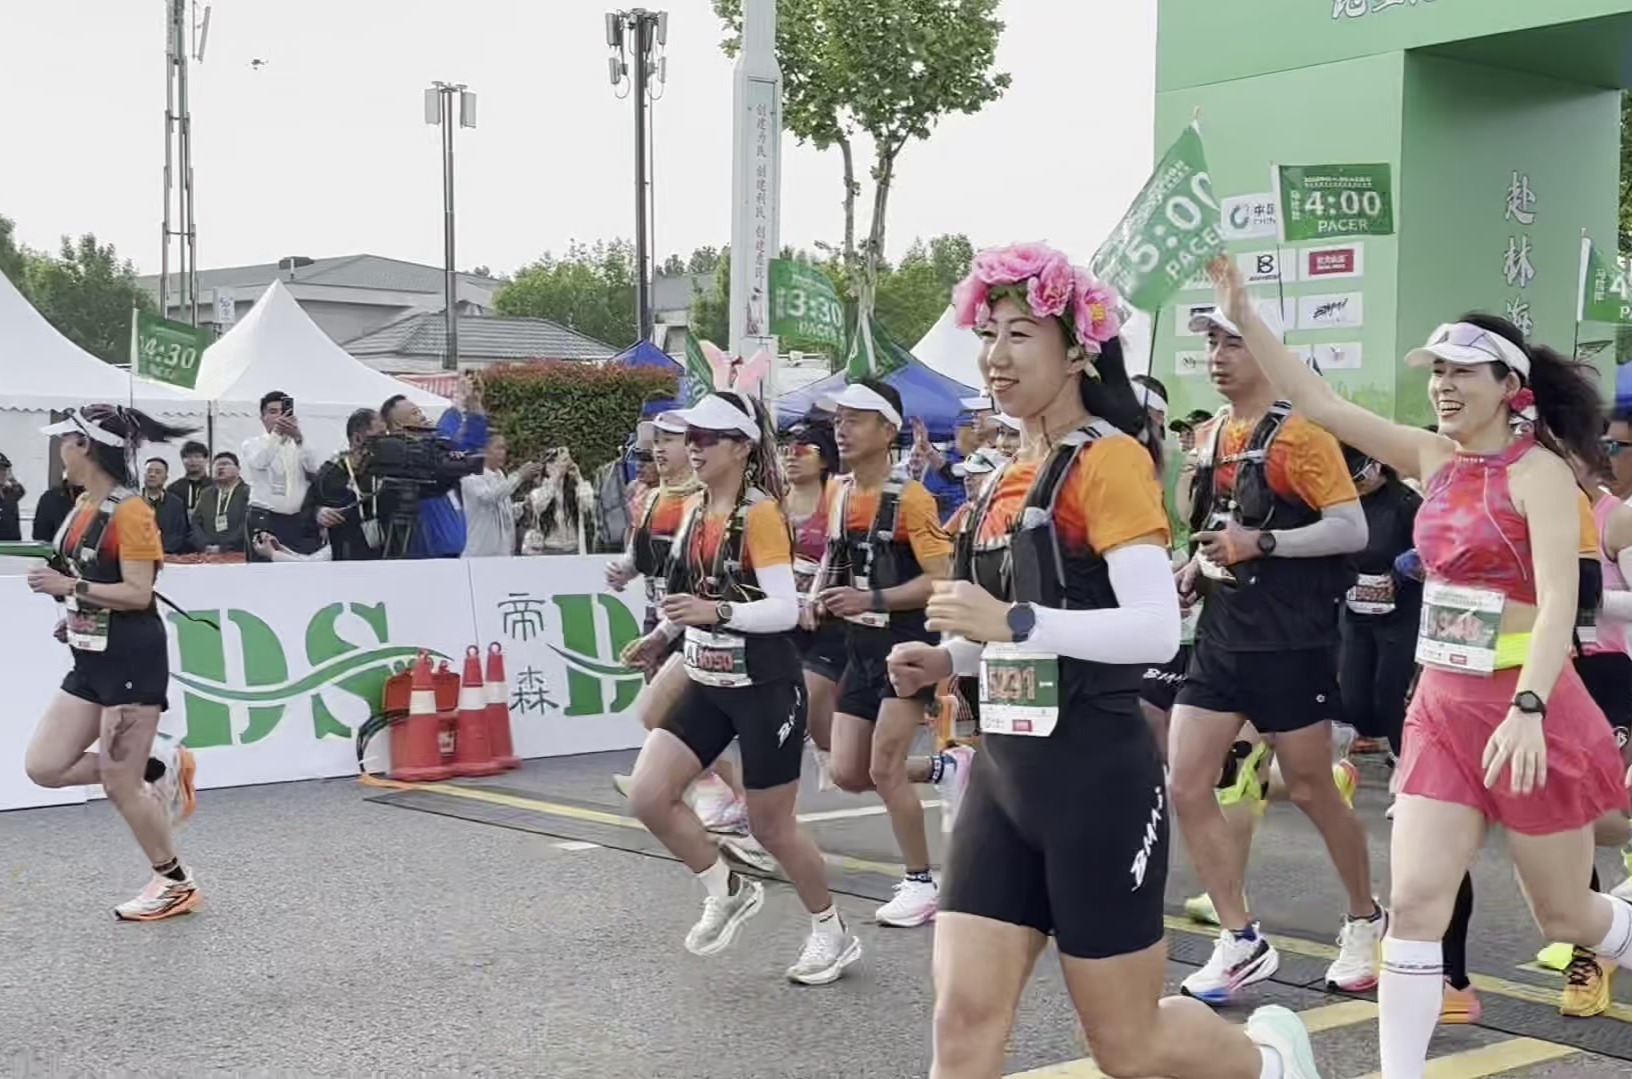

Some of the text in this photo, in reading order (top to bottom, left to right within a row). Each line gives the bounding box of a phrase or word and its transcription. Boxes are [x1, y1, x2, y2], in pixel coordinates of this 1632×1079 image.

[1304, 190, 1381, 216] 4:00
[1318, 218, 1369, 233] PACER
[786, 289, 842, 328] 3:30
[144, 338, 197, 369] 4:30
